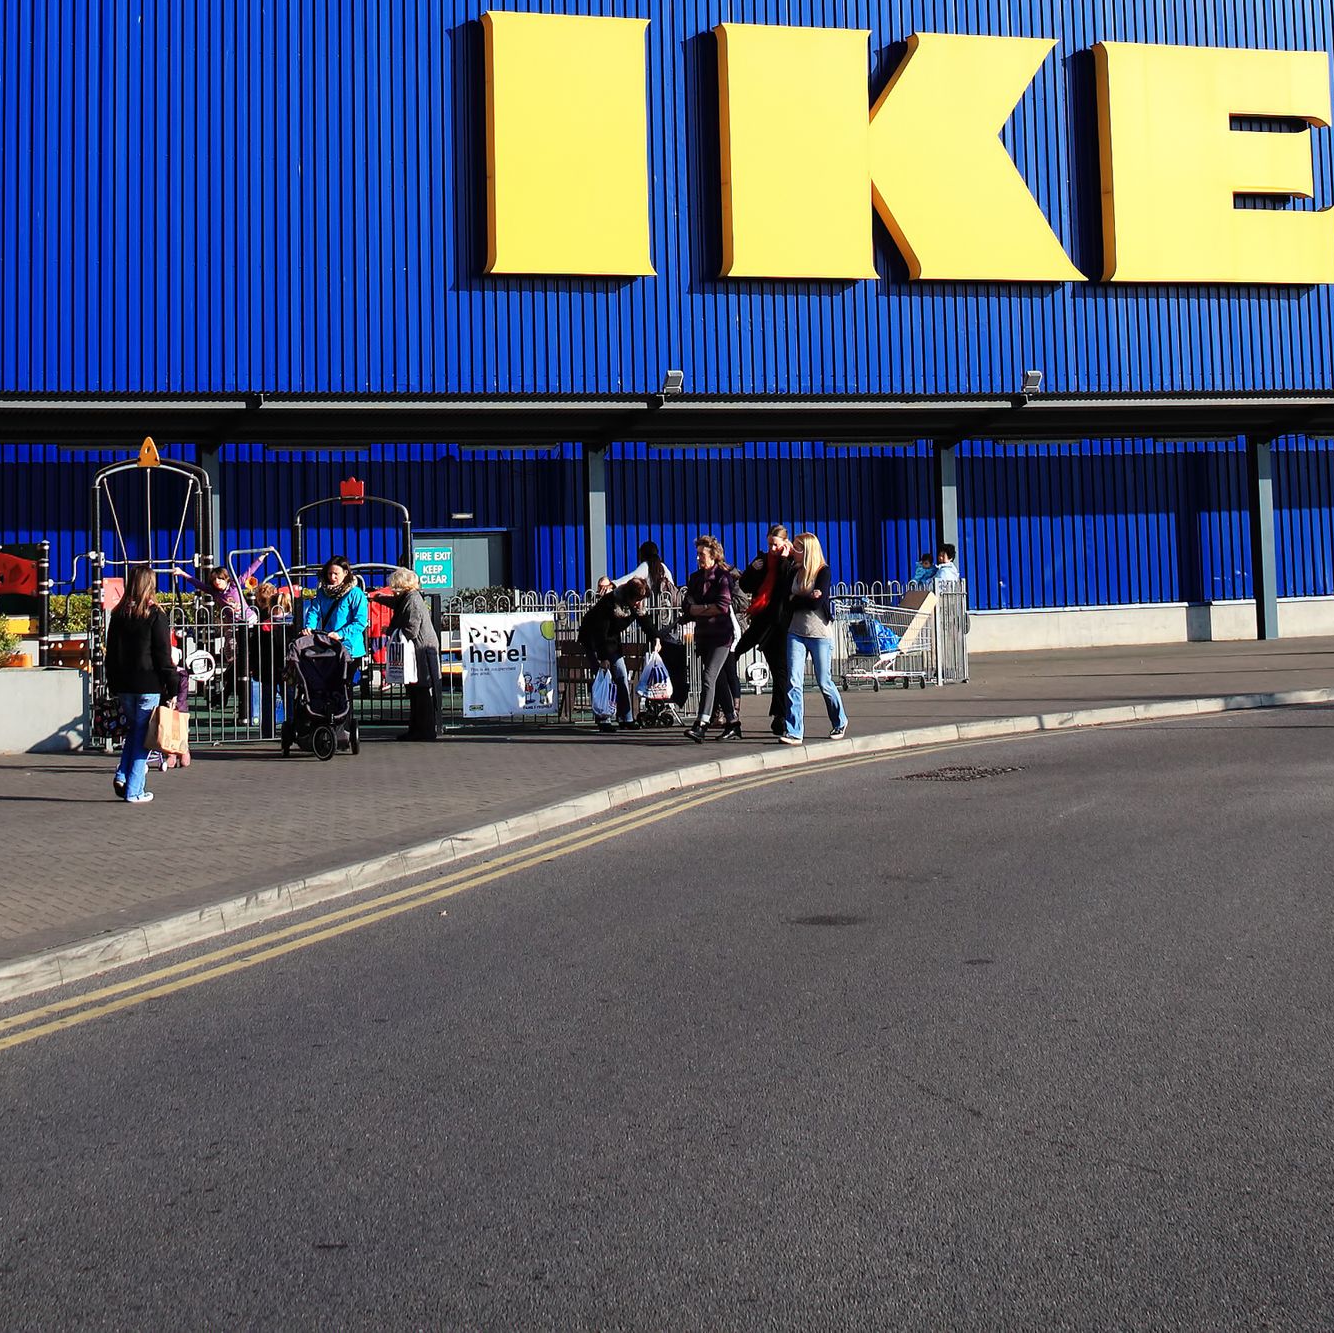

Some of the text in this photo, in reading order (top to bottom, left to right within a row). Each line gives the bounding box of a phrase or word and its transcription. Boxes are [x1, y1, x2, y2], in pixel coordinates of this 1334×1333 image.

[415, 552, 451, 561] FIRE EXIT
[422, 565, 443, 574] KEEP
[420, 575, 447, 584] CLEAR
[468, 626, 515, 646] Play
[469, 645, 527, 663] here!
